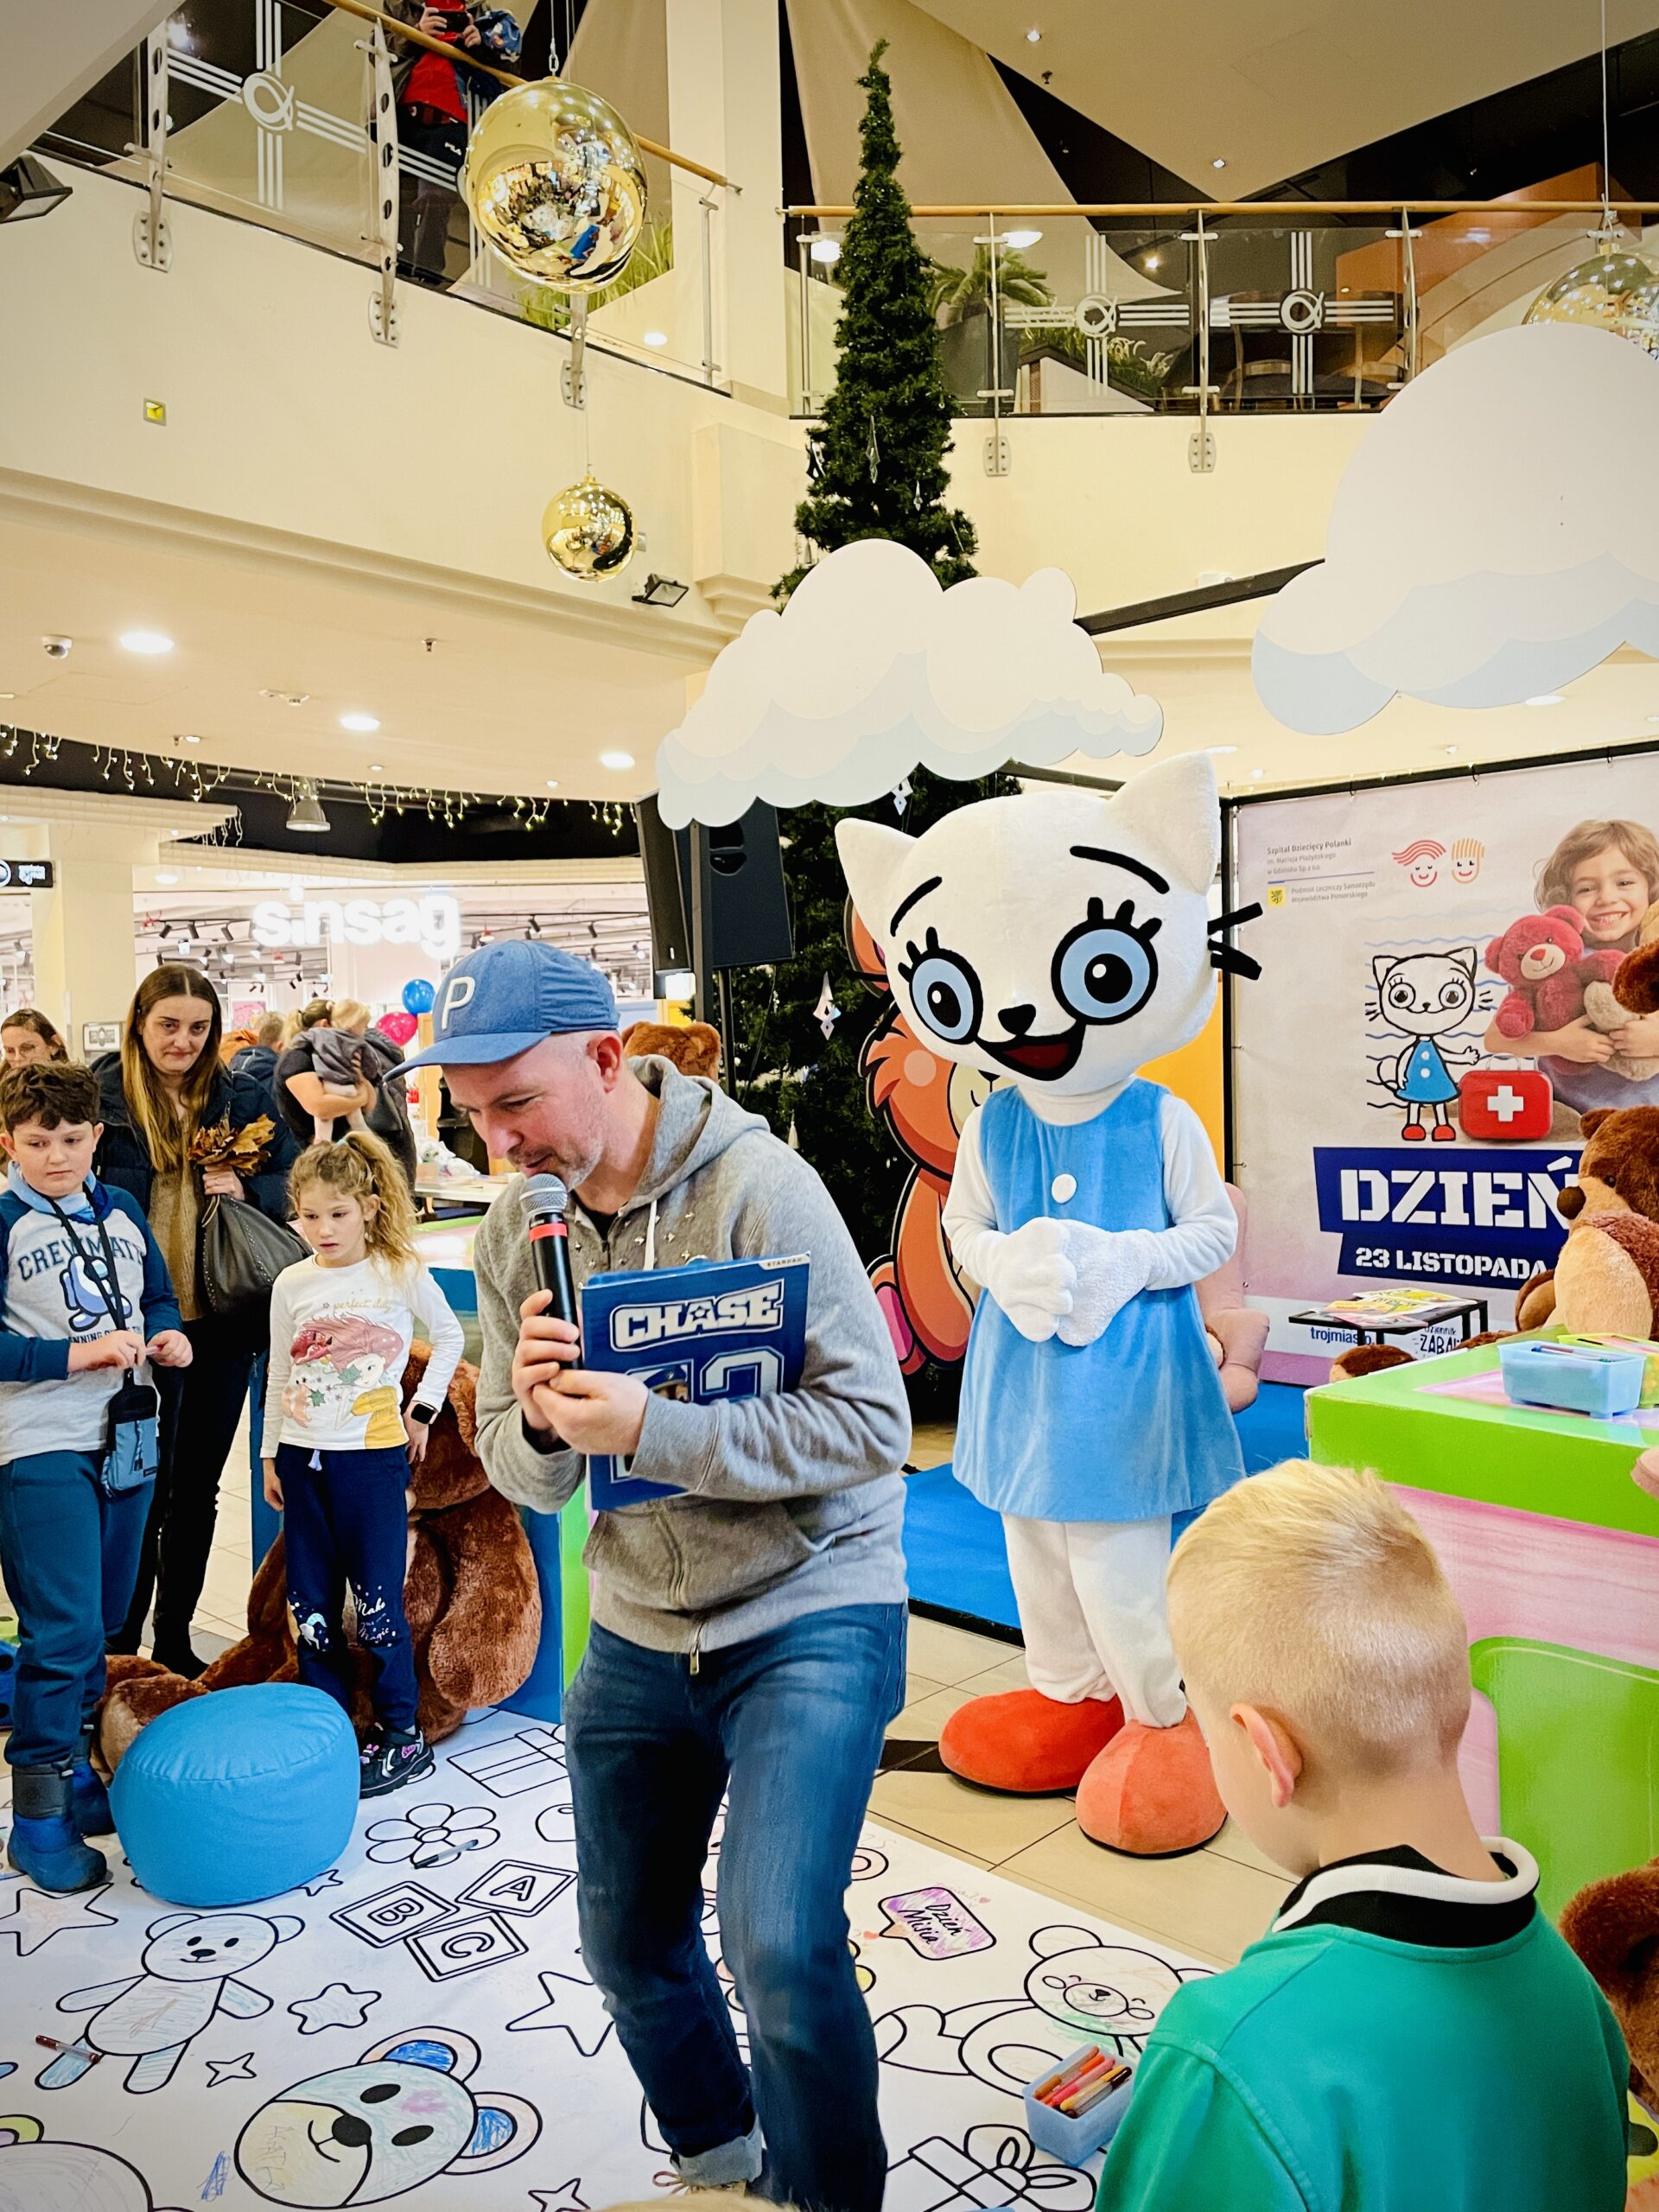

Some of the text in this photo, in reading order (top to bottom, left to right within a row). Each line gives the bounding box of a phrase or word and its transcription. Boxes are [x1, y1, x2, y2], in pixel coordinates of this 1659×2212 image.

[1325, 838, 1352, 849] Polanki
[442, 976, 476, 1030] P
[1355, 1247, 1548, 1280] 23 LISTOPADA
[613, 1281, 782, 1350] CHASE
[488, 1874, 537, 1902] A
[366, 1897, 425, 1927] B
[441, 1931, 496, 1959] C
